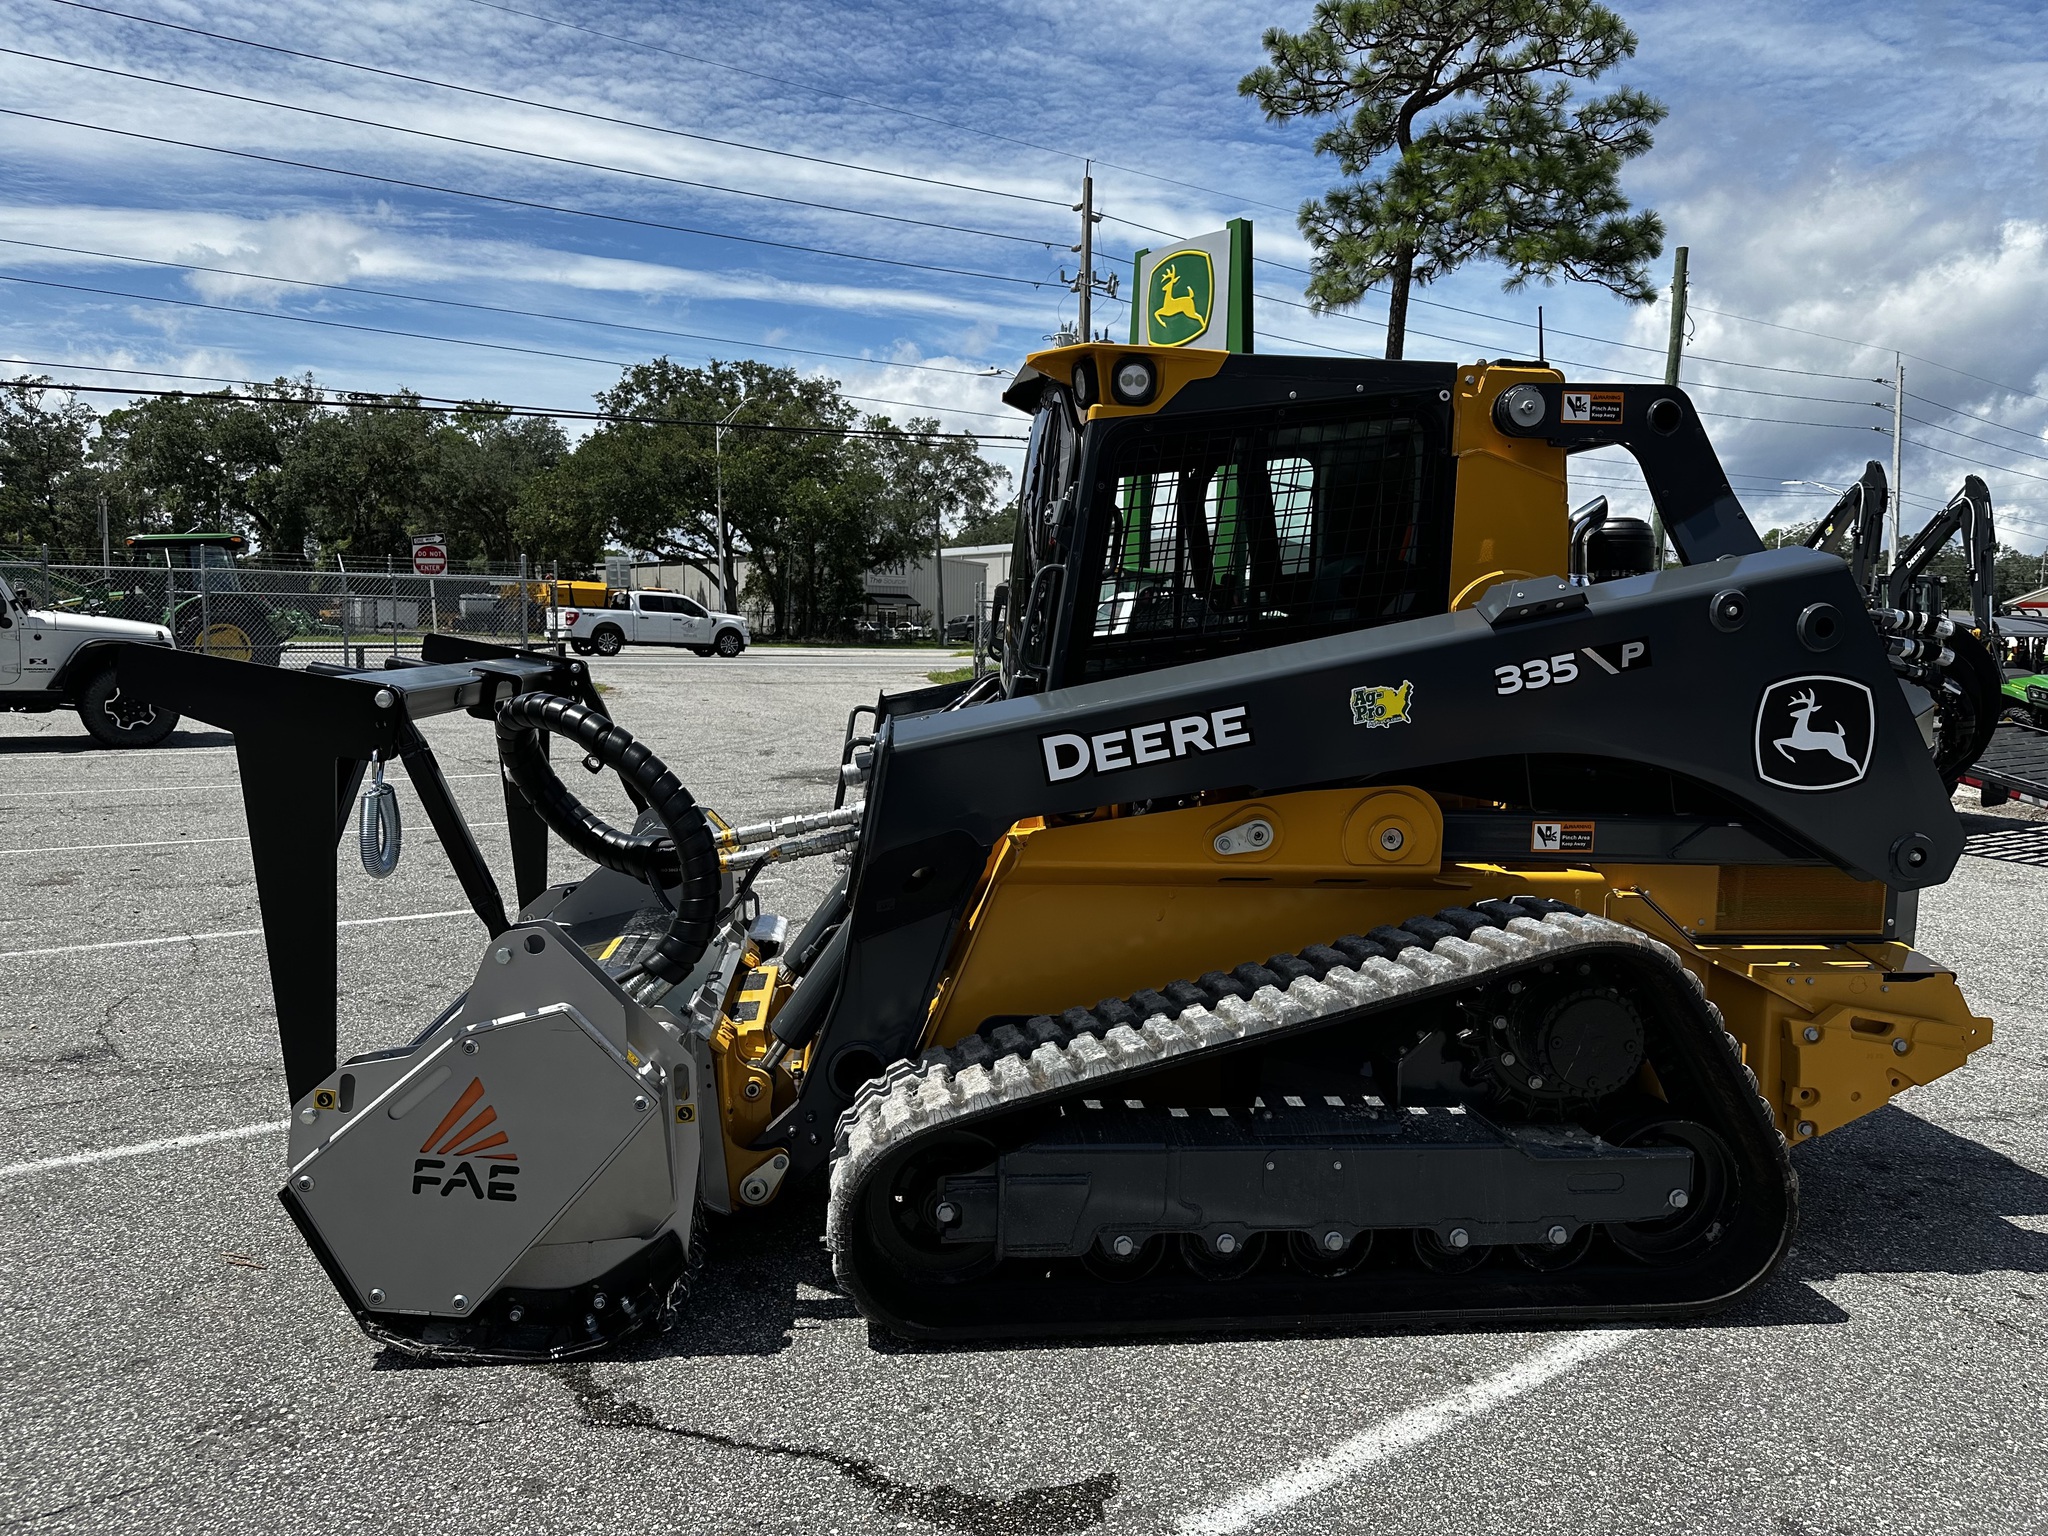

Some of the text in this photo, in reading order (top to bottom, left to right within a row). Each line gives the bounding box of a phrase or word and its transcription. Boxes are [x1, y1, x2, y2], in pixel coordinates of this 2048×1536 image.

[883, 577, 907, 585] Source
[1494, 652, 1579, 695] 335
[1355, 705, 1387, 721] Pro
[1042, 706, 1250, 782] DEERE
[412, 1159, 520, 1202] FAE
